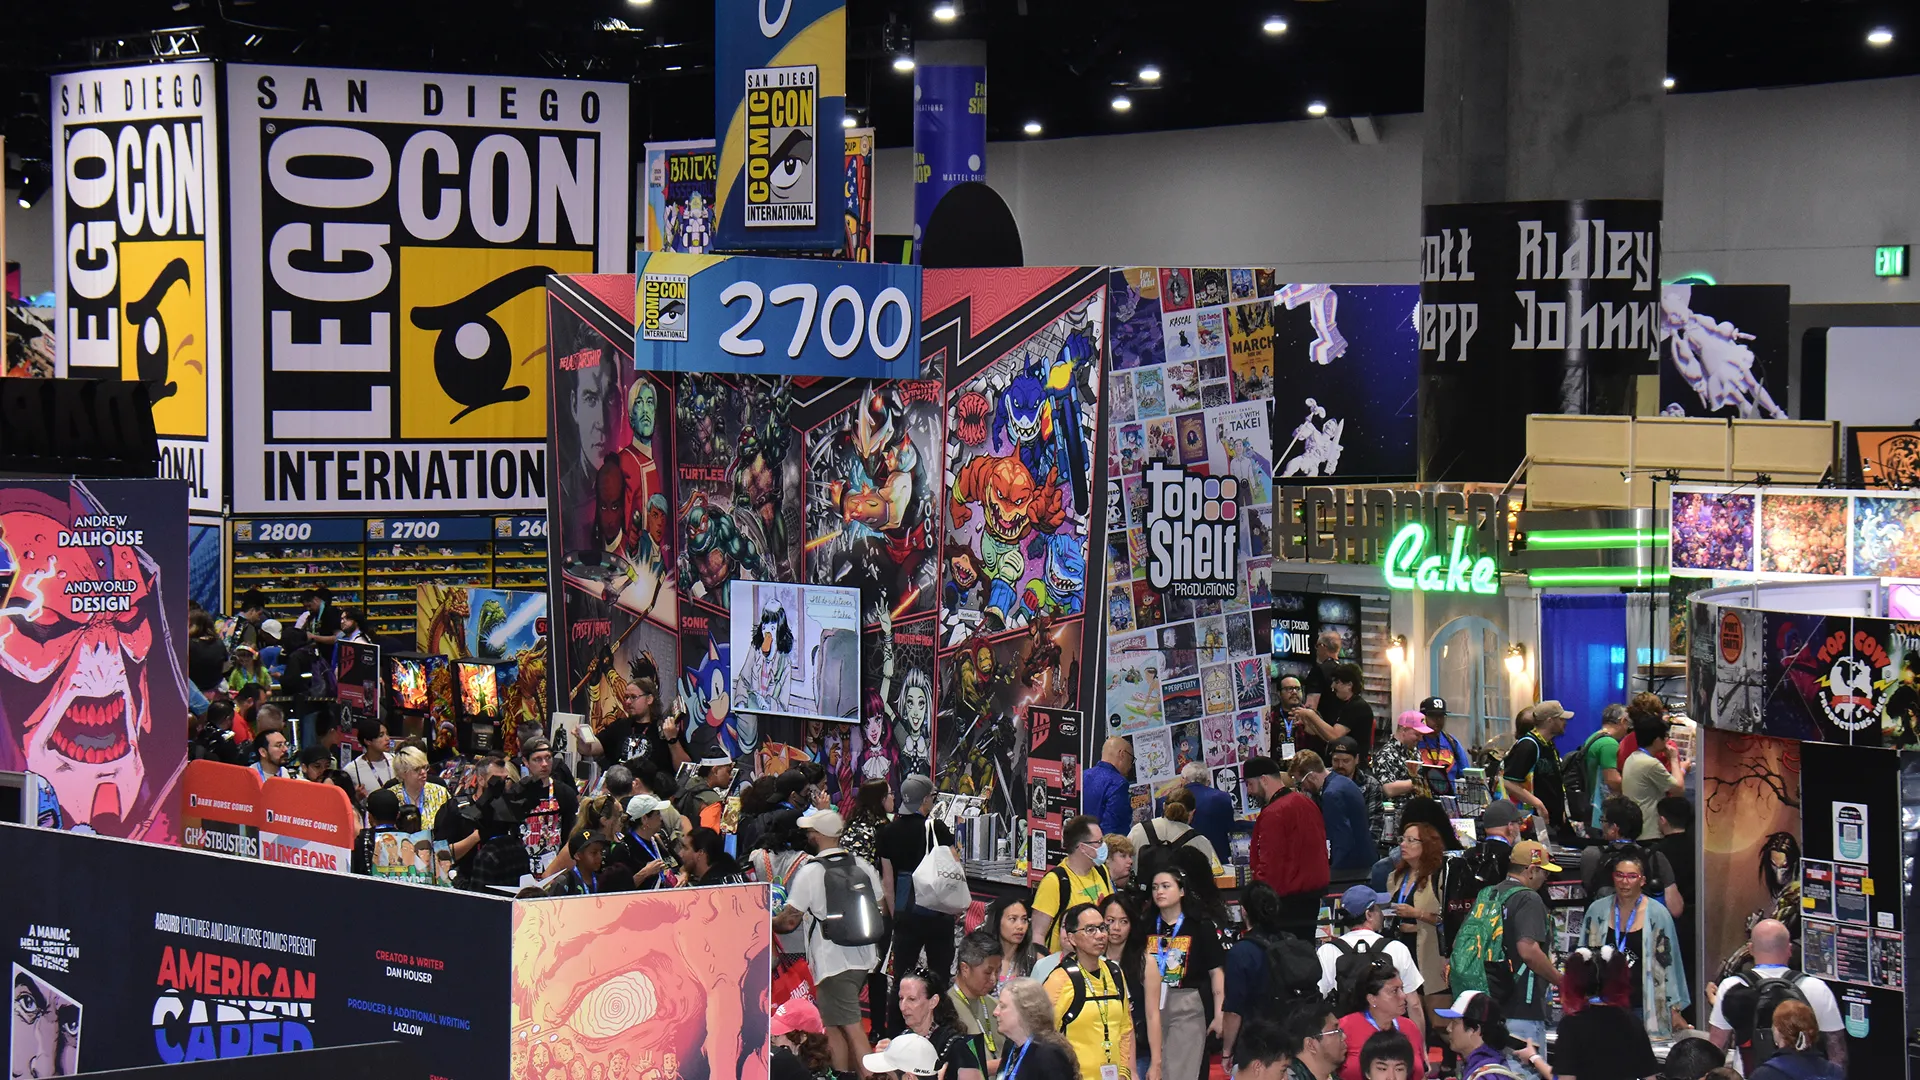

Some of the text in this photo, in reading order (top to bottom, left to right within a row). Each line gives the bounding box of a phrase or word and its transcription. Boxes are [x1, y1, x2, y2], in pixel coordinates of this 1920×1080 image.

[747, 71, 814, 88] SAN DIEGO
[61, 73, 203, 116] SAN DIEGO
[257, 75, 601, 123] SAN DIEGO
[772, 89, 812, 127] CON
[749, 91, 770, 203] COMIC
[117, 122, 204, 238] CON
[943, 173, 969, 182] MATTEL
[398, 130, 595, 245] CON
[747, 205, 813, 221] INTERNATIONAL
[1516, 220, 1653, 291] Ridley
[1875, 246, 1903, 276] EXIT
[268, 126, 392, 439] LEGO
[660, 282, 686, 299] CON
[646, 282, 660, 329] COMIC
[718, 280, 912, 360] 2700
[1169, 315, 1192, 328] RASCAL
[1420, 290, 1661, 362] epp Johnny
[645, 330, 686, 339] INTERNATIONAL
[1232, 336, 1275, 355] MARCH
[1244, 410, 1261, 418] WITH
[1230, 417, 1261, 432] TAKEI
[264, 448, 546, 501] INTERNATION
[679, 468, 725, 481] TURTLES
[74, 515, 128, 528] ANDREW
[391, 521, 440, 540] 2700
[57, 530, 144, 547] DALHOUSE
[259, 523, 312, 542] 2800
[1150, 519, 1237, 589] Shelf
[1384, 523, 1500, 595] Cake
[64, 580, 137, 594] ANDWORLD
[1171, 582, 1236, 597] PRODUCTIONS
[71, 596, 130, 612] DESIGN
[572, 622, 590, 642] CASEY
[682, 616, 709, 629] SONIC
[1817, 630, 1846, 664] TOP
[1853, 630, 1891, 669] COW
[1168, 680, 1198, 693] PERPETUITY
[197, 797, 253, 813] DARK HORSE COMICS
[274, 813, 338, 833] DARK HORSE COMICS
[582, 830, 591, 840] P
[29, 924, 71, 941] A MANIAC
[155, 912, 317, 957] ABSURD VENTURES AND DARK HORSE COMICS PRESENT
[66, 944, 80, 959] ON
[375, 950, 444, 970] CREATOR & WRITER
[157, 945, 316, 999] AMERICAN
[386, 966, 433, 984] DAN HOUSER
[347, 998, 471, 1031] PRODUCER & ADDITIONAL WRITING
[393, 1021, 424, 1036] LAZLOW
